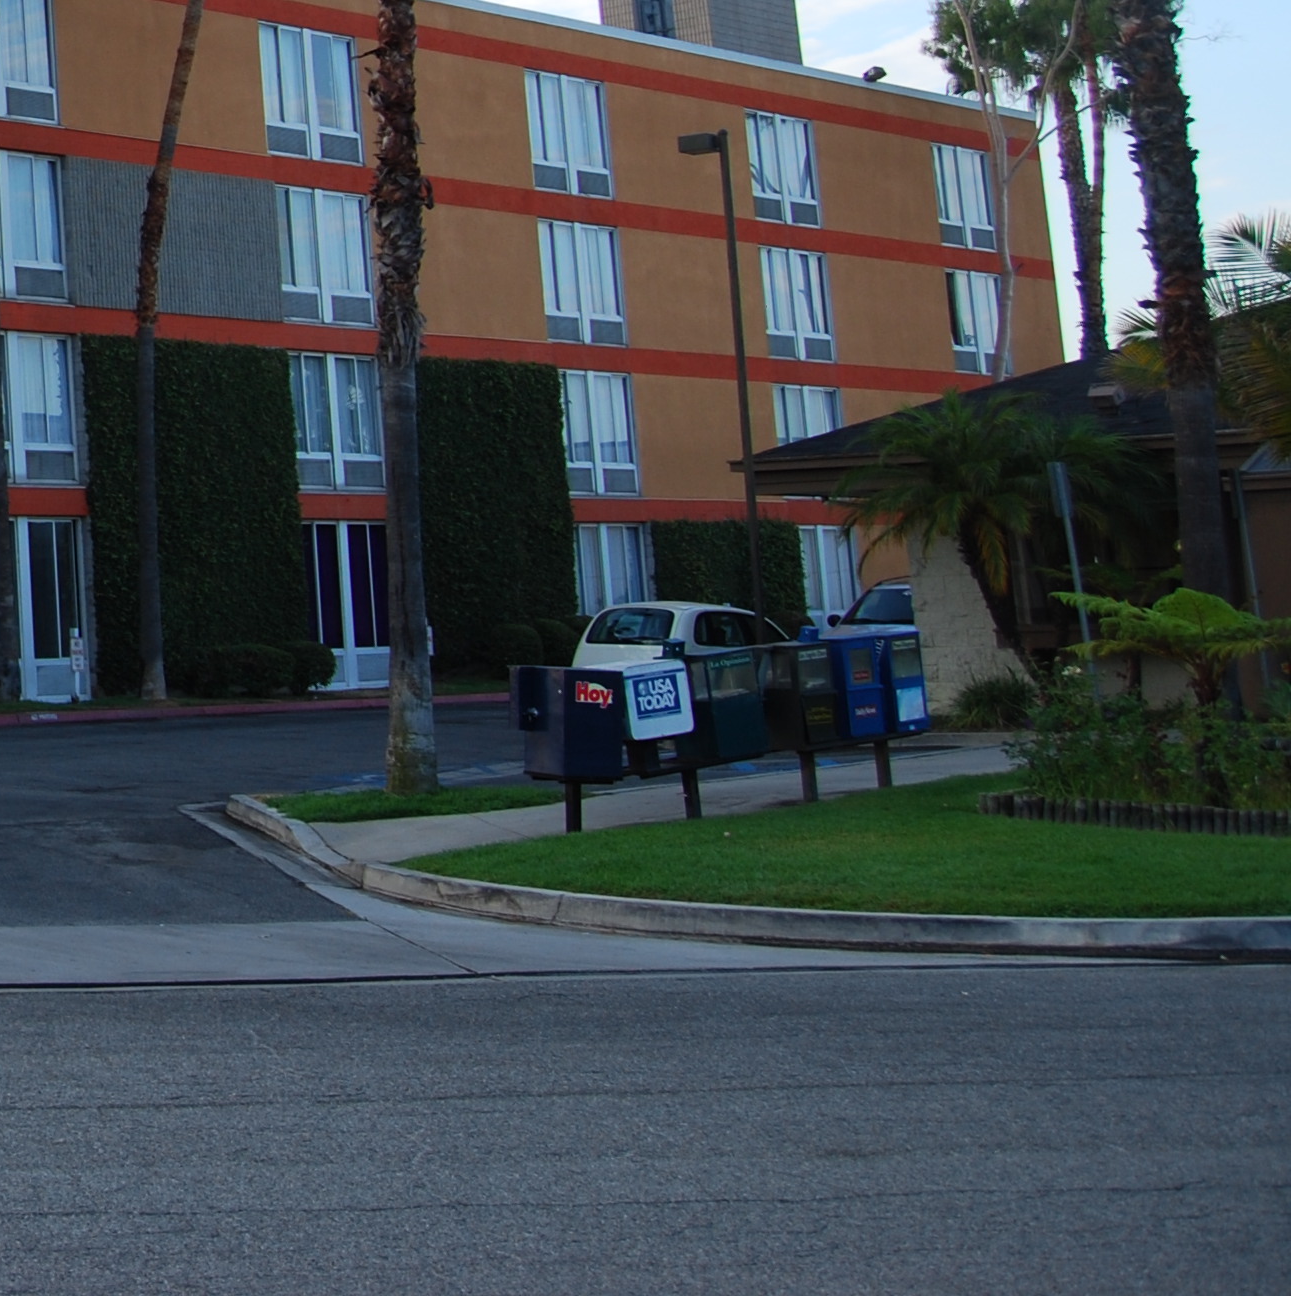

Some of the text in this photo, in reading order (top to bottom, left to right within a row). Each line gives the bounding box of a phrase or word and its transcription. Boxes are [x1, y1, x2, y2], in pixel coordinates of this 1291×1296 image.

[575, 681, 612, 709] Hoy
[648, 677, 674, 694] USA
[637, 690, 676, 712] TODAY
